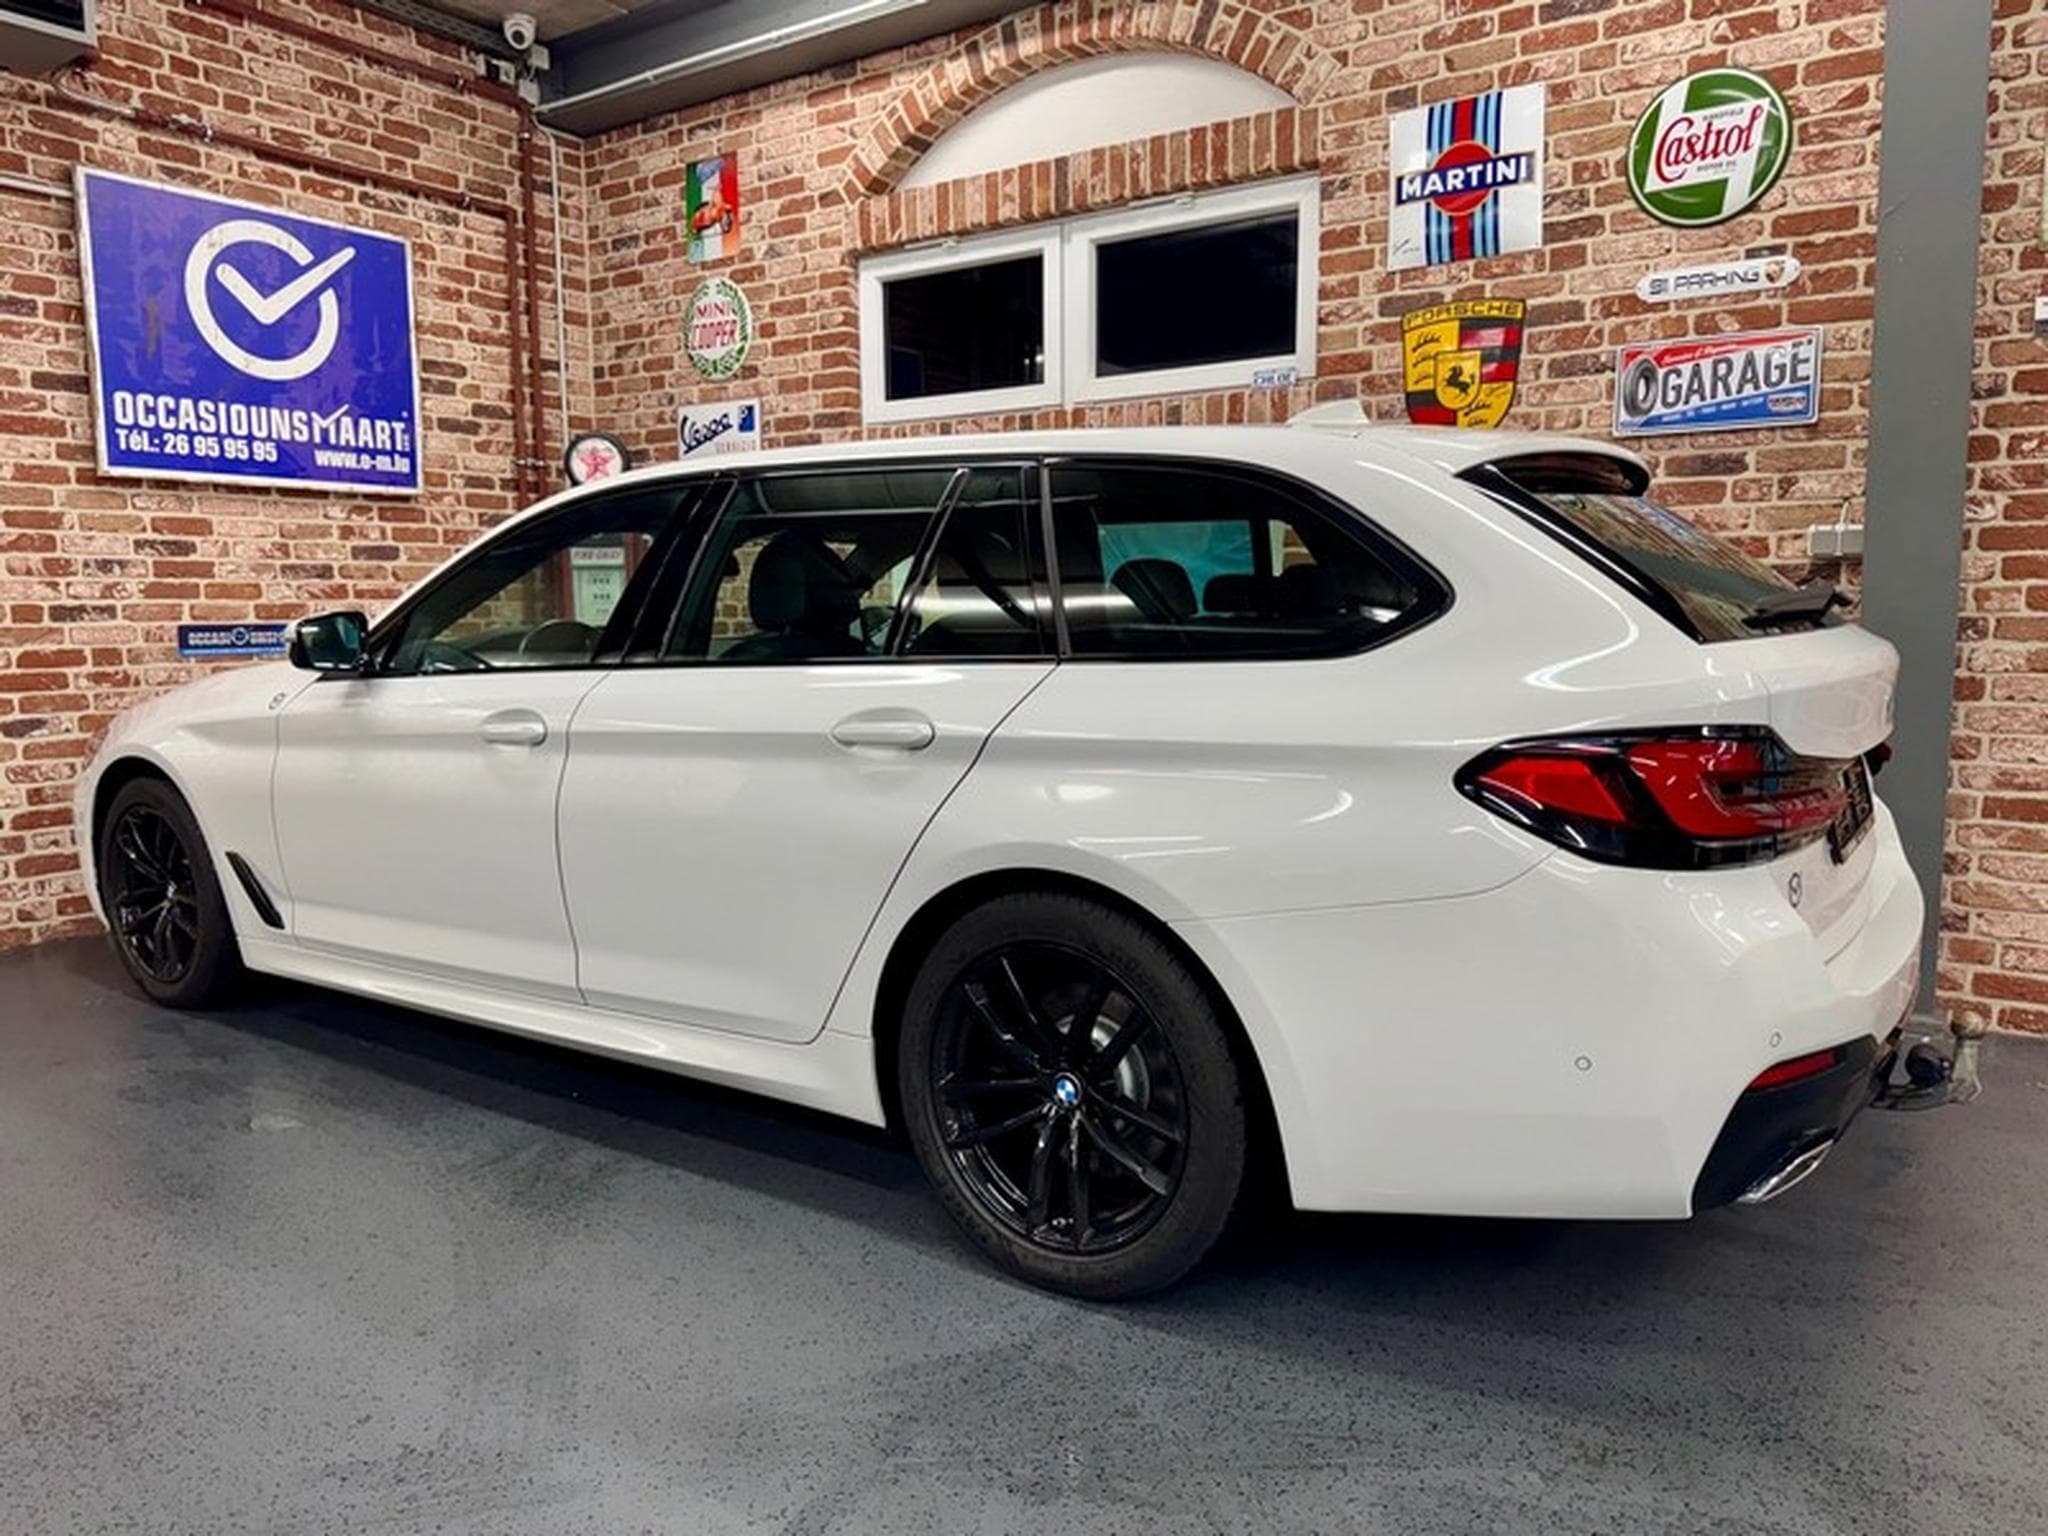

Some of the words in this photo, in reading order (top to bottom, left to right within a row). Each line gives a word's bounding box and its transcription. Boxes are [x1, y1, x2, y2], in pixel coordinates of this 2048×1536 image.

[1655, 104, 1765, 185] Castrol
[1401, 156, 1527, 201] MARTINI
[1673, 268, 1760, 292] PARKING
[695, 302, 731, 319] MINI
[1404, 301, 1521, 328] PORSCHE
[1660, 344, 1812, 410] GARAGE
[113, 390, 406, 452] OCCASIOUNSMAART
[680, 413, 734, 455] Vespa
[163, 431, 190, 457] 26
[192, 434, 221, 459] 95
[222, 437, 250, 461] 95
[251, 440, 279, 464] 95
